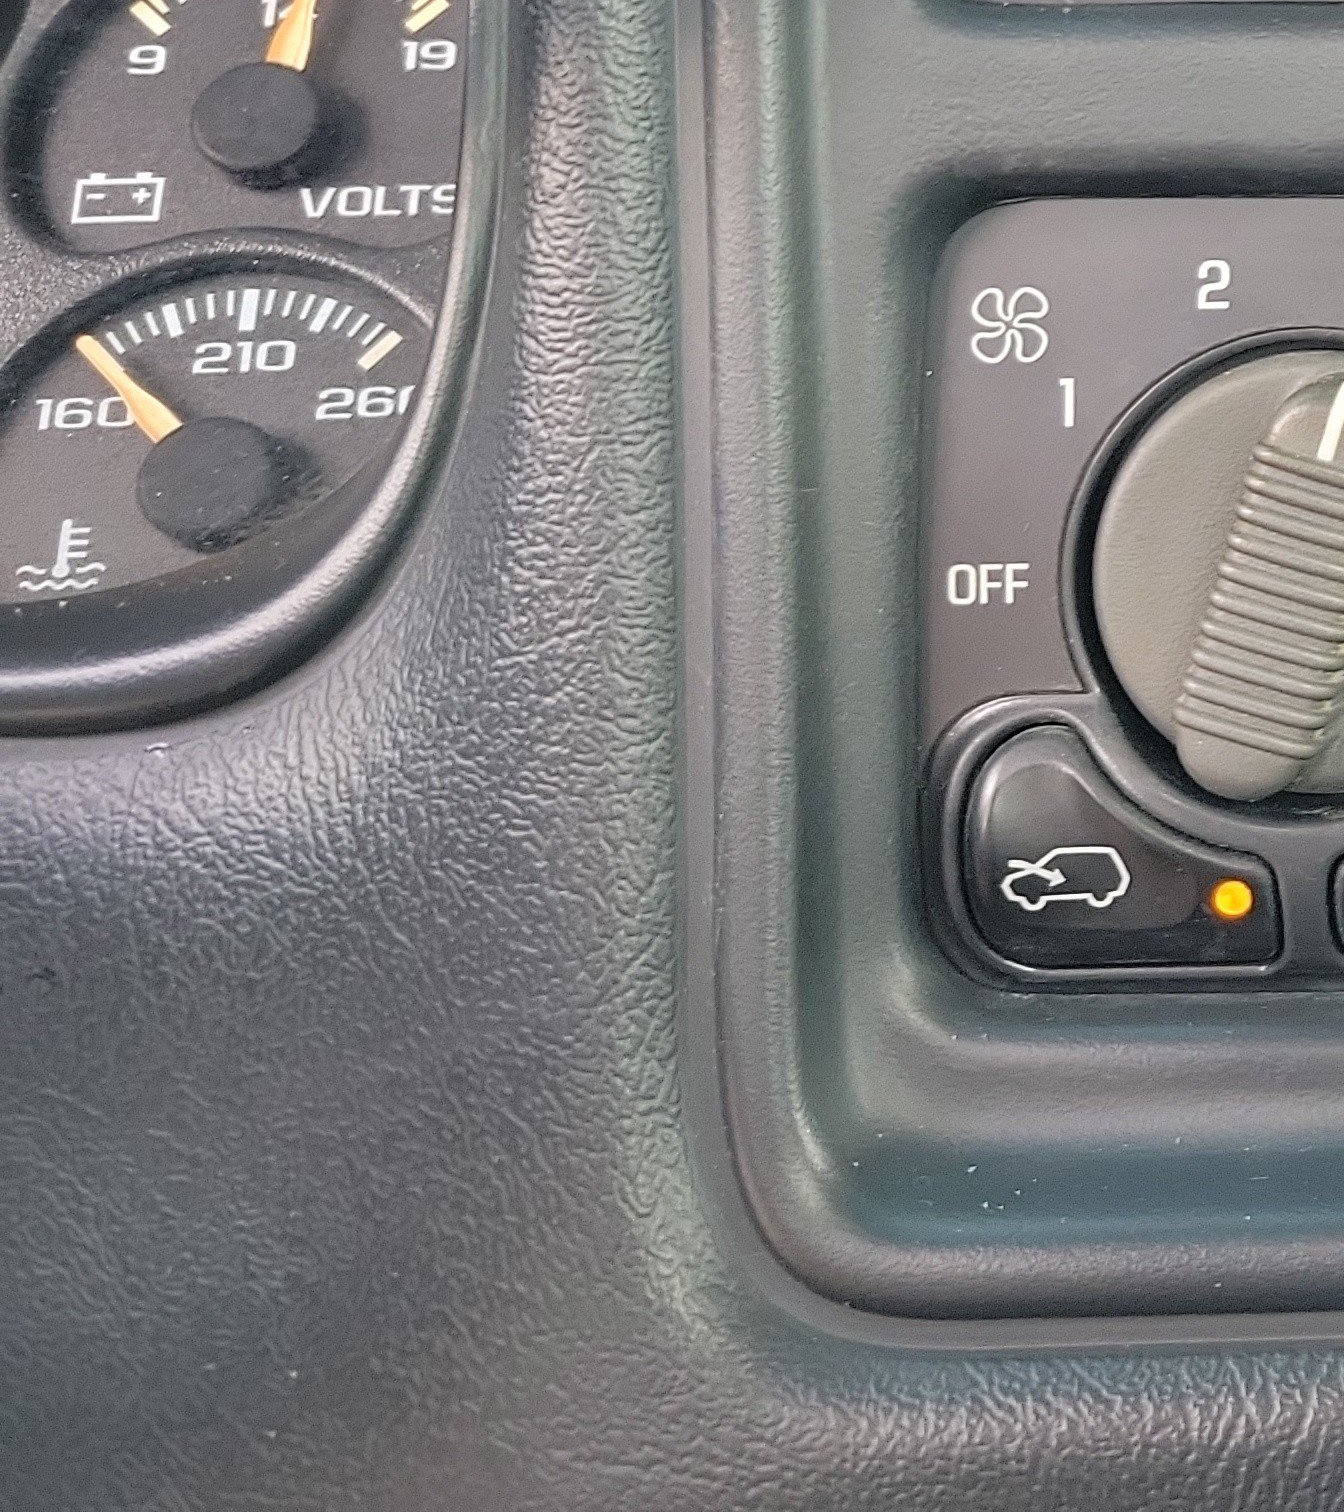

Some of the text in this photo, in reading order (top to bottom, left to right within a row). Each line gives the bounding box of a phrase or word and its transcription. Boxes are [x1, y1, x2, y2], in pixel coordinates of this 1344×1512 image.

[127, 44, 167, 76] 9
[403, 40, 457, 71] 19
[300, 183, 457, 218] VOLTS
[1196, 259, 1231, 310] 2
[192, 340, 297, 374] 210
[35, 396, 134, 431] 160
[1058, 377, 1075, 428] 1
[947, 562, 1030, 605] OFF
